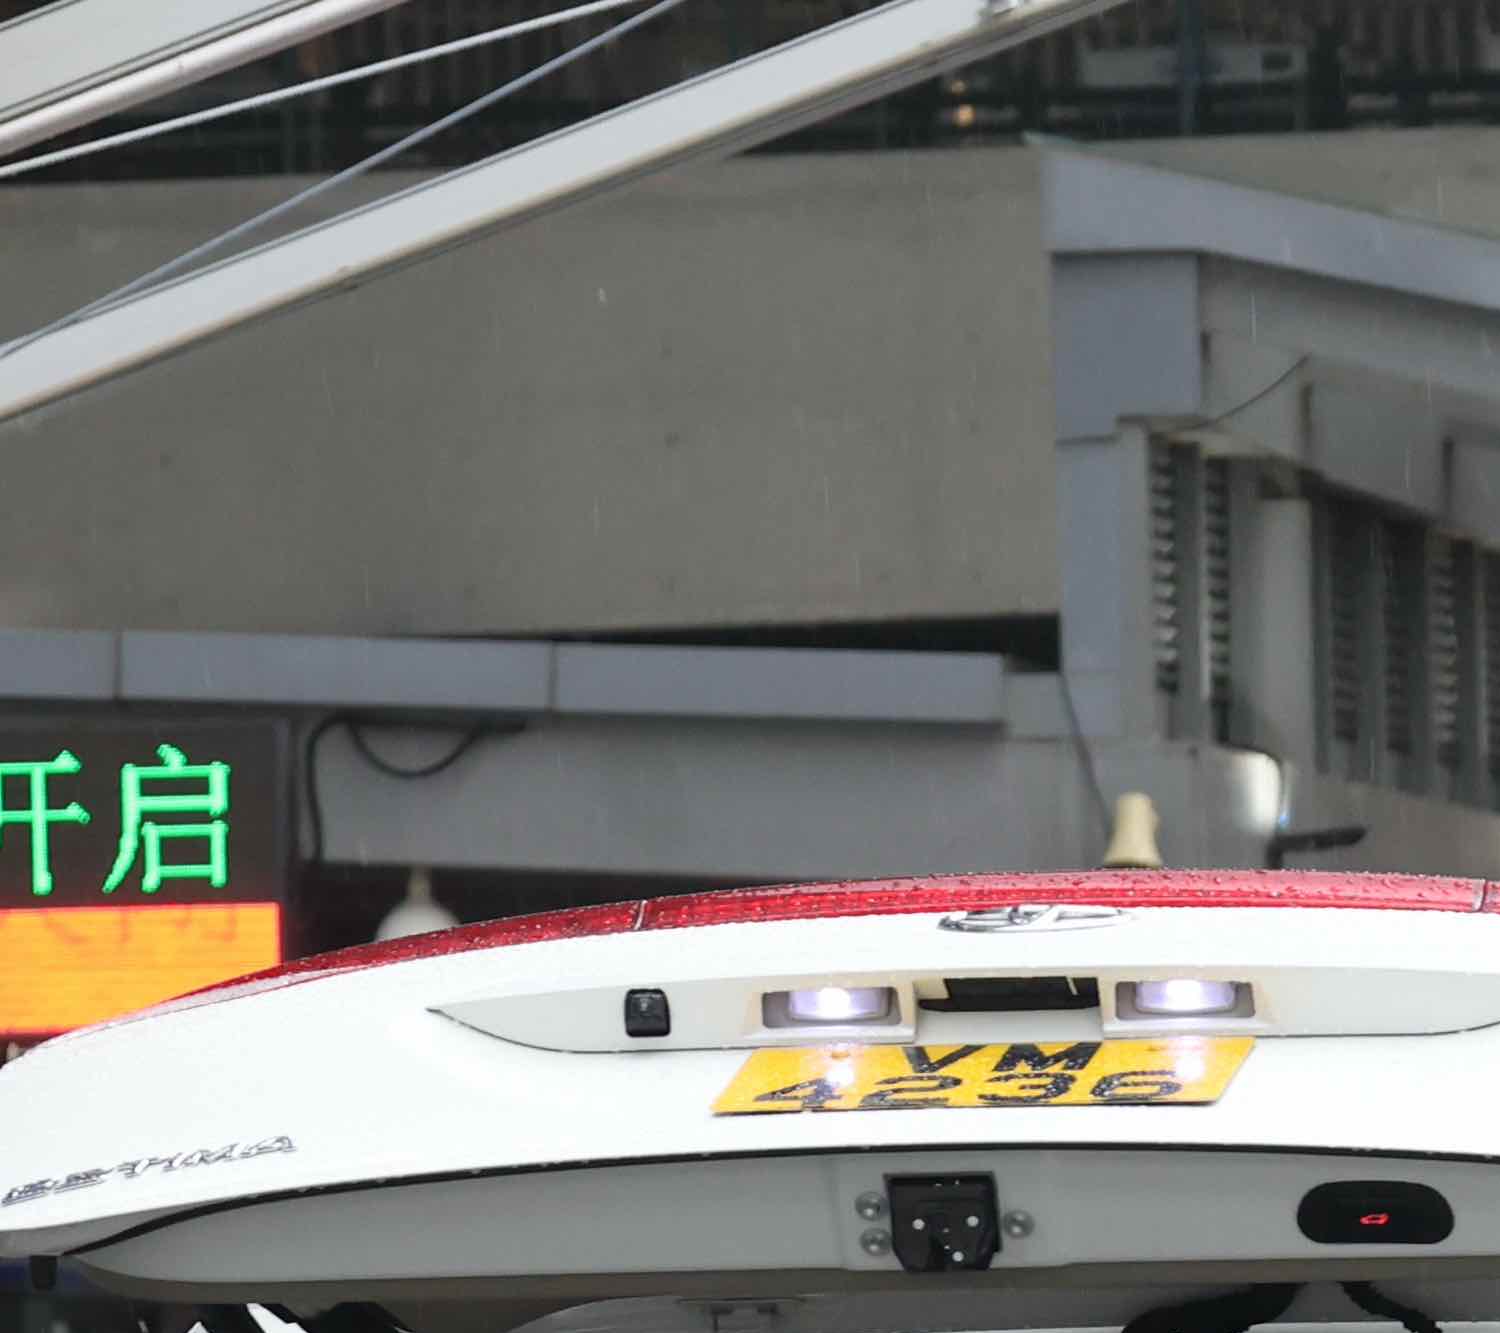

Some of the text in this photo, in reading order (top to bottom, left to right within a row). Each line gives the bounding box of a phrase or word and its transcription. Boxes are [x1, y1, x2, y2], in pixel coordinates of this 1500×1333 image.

[0, 742, 230, 896] 开启
[901, 1043, 1102, 1073] VM
[753, 1069, 1184, 1109] 4236
